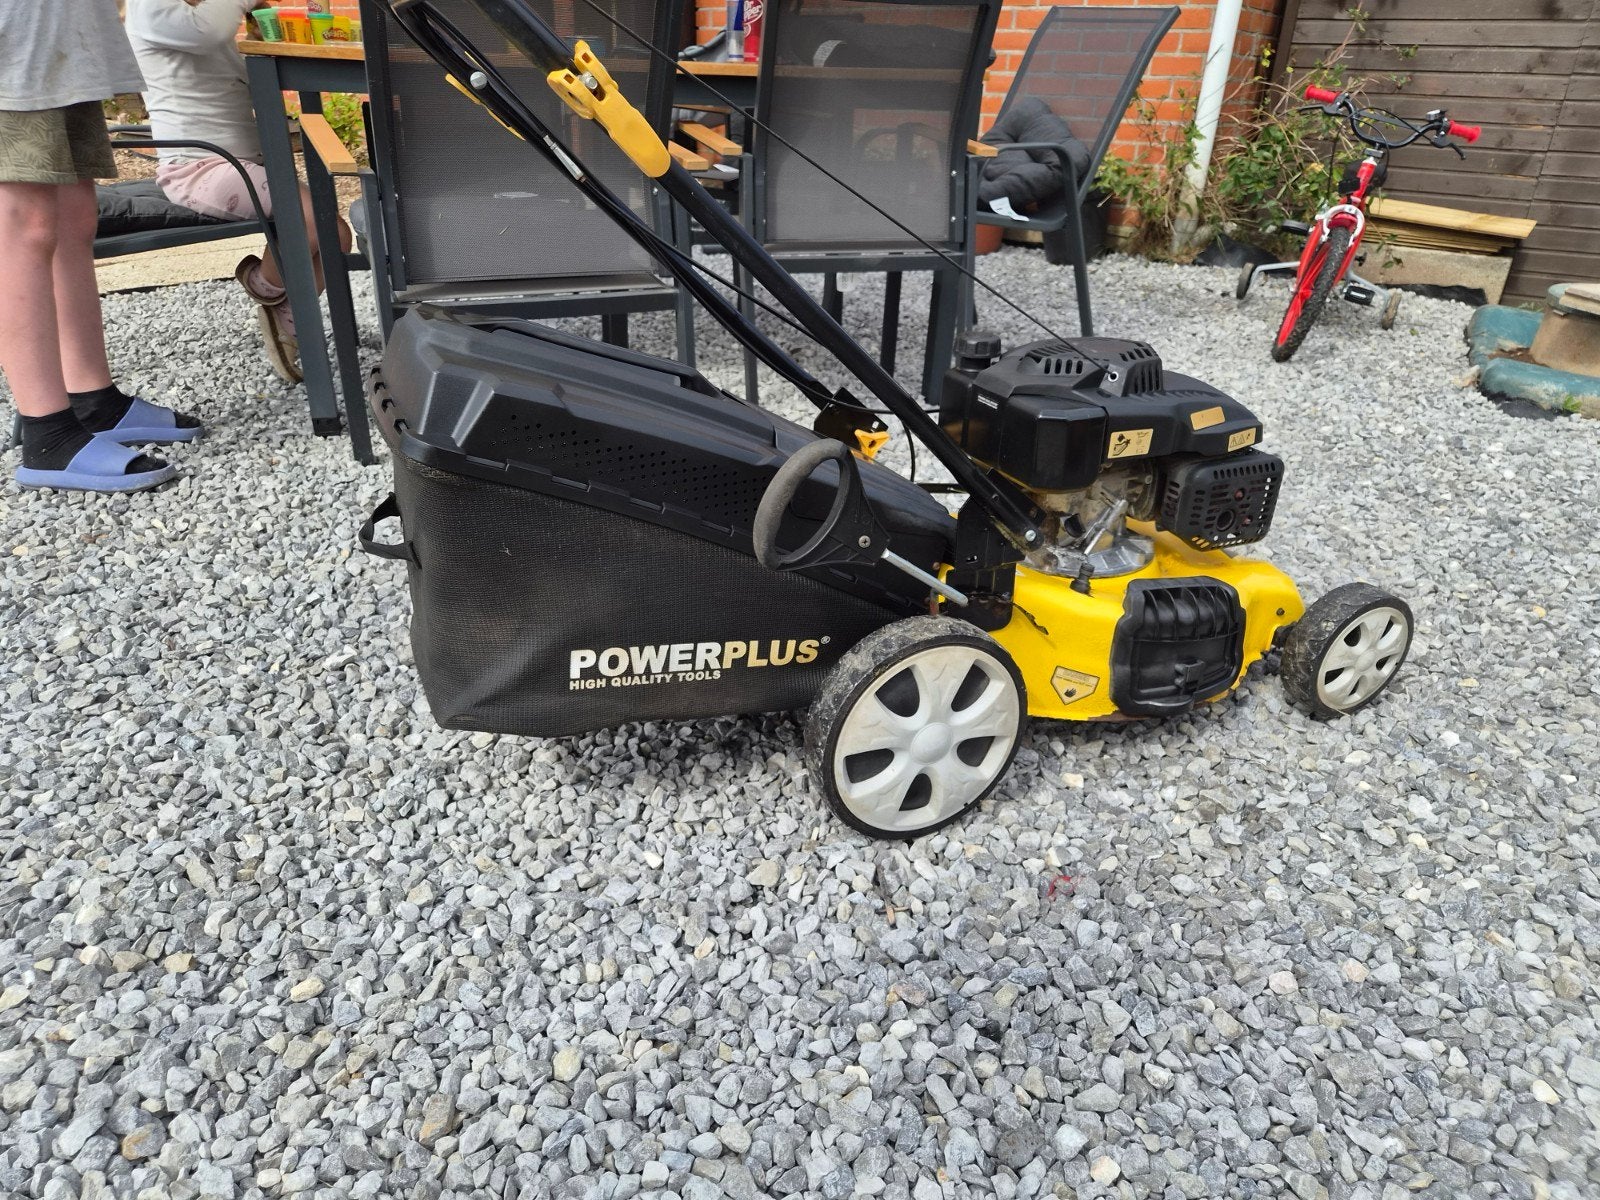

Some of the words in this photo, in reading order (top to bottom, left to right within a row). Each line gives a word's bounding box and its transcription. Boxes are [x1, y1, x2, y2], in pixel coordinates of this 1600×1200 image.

[569, 677, 607, 691] HIGH
[611, 673, 673, 687] QUALITY
[677, 669, 721, 682] TOOLS
